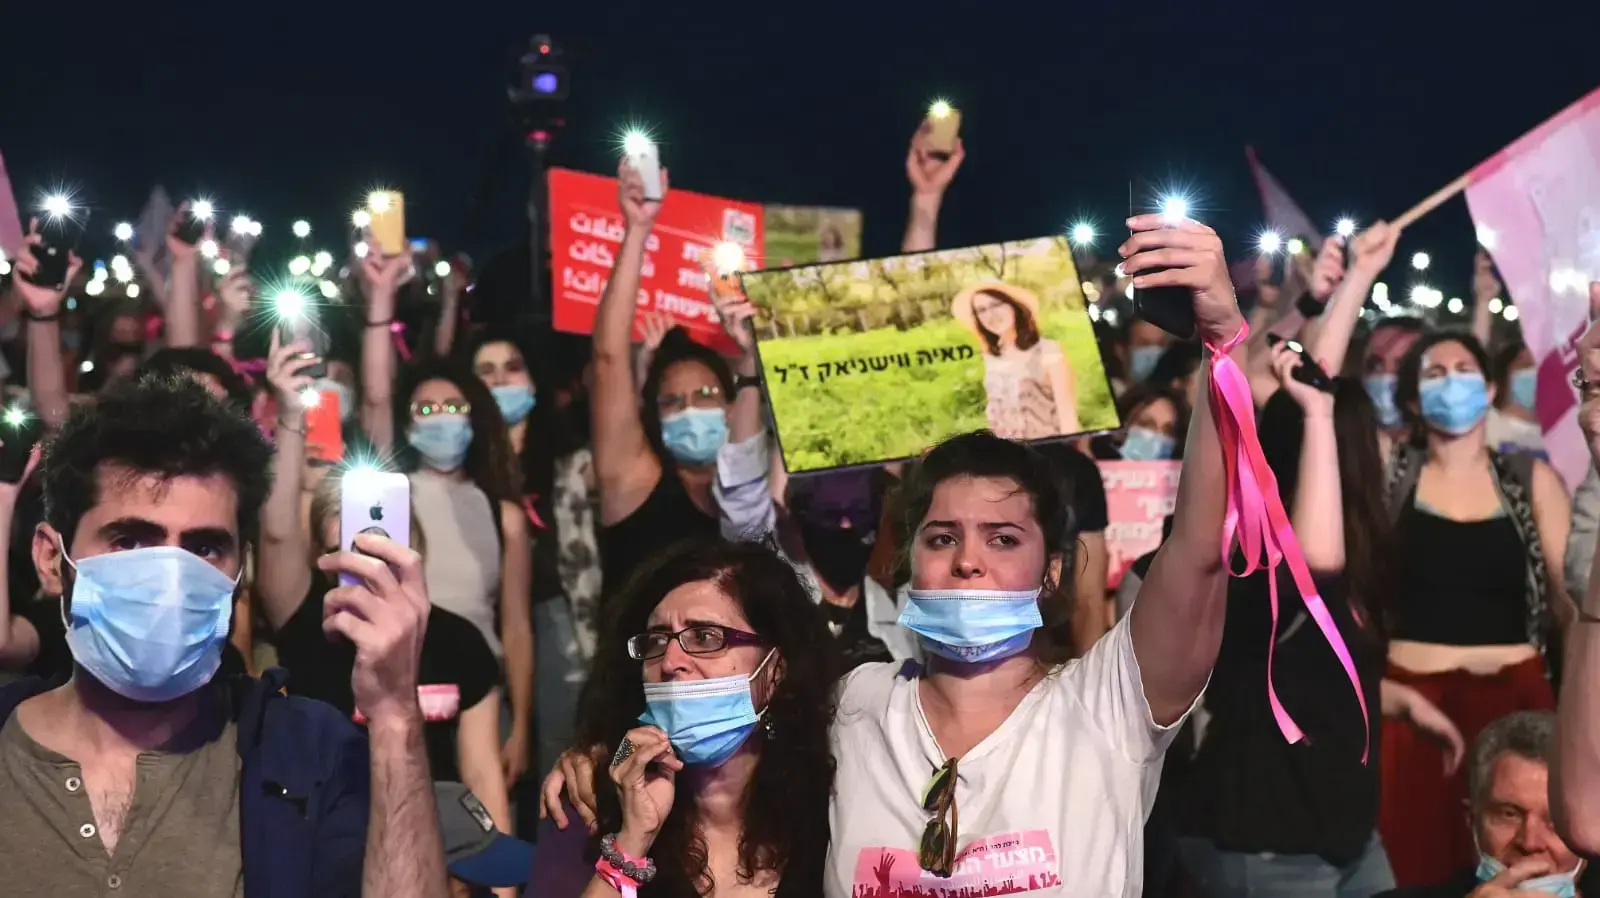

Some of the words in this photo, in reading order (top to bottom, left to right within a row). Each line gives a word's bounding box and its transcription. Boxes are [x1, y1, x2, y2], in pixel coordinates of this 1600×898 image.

[916, 344, 974, 366] מאיה
[774, 363, 809, 383] ז"ל
[817, 352, 910, 383] ווישניאק
[984, 846, 1046, 870] מצעד
